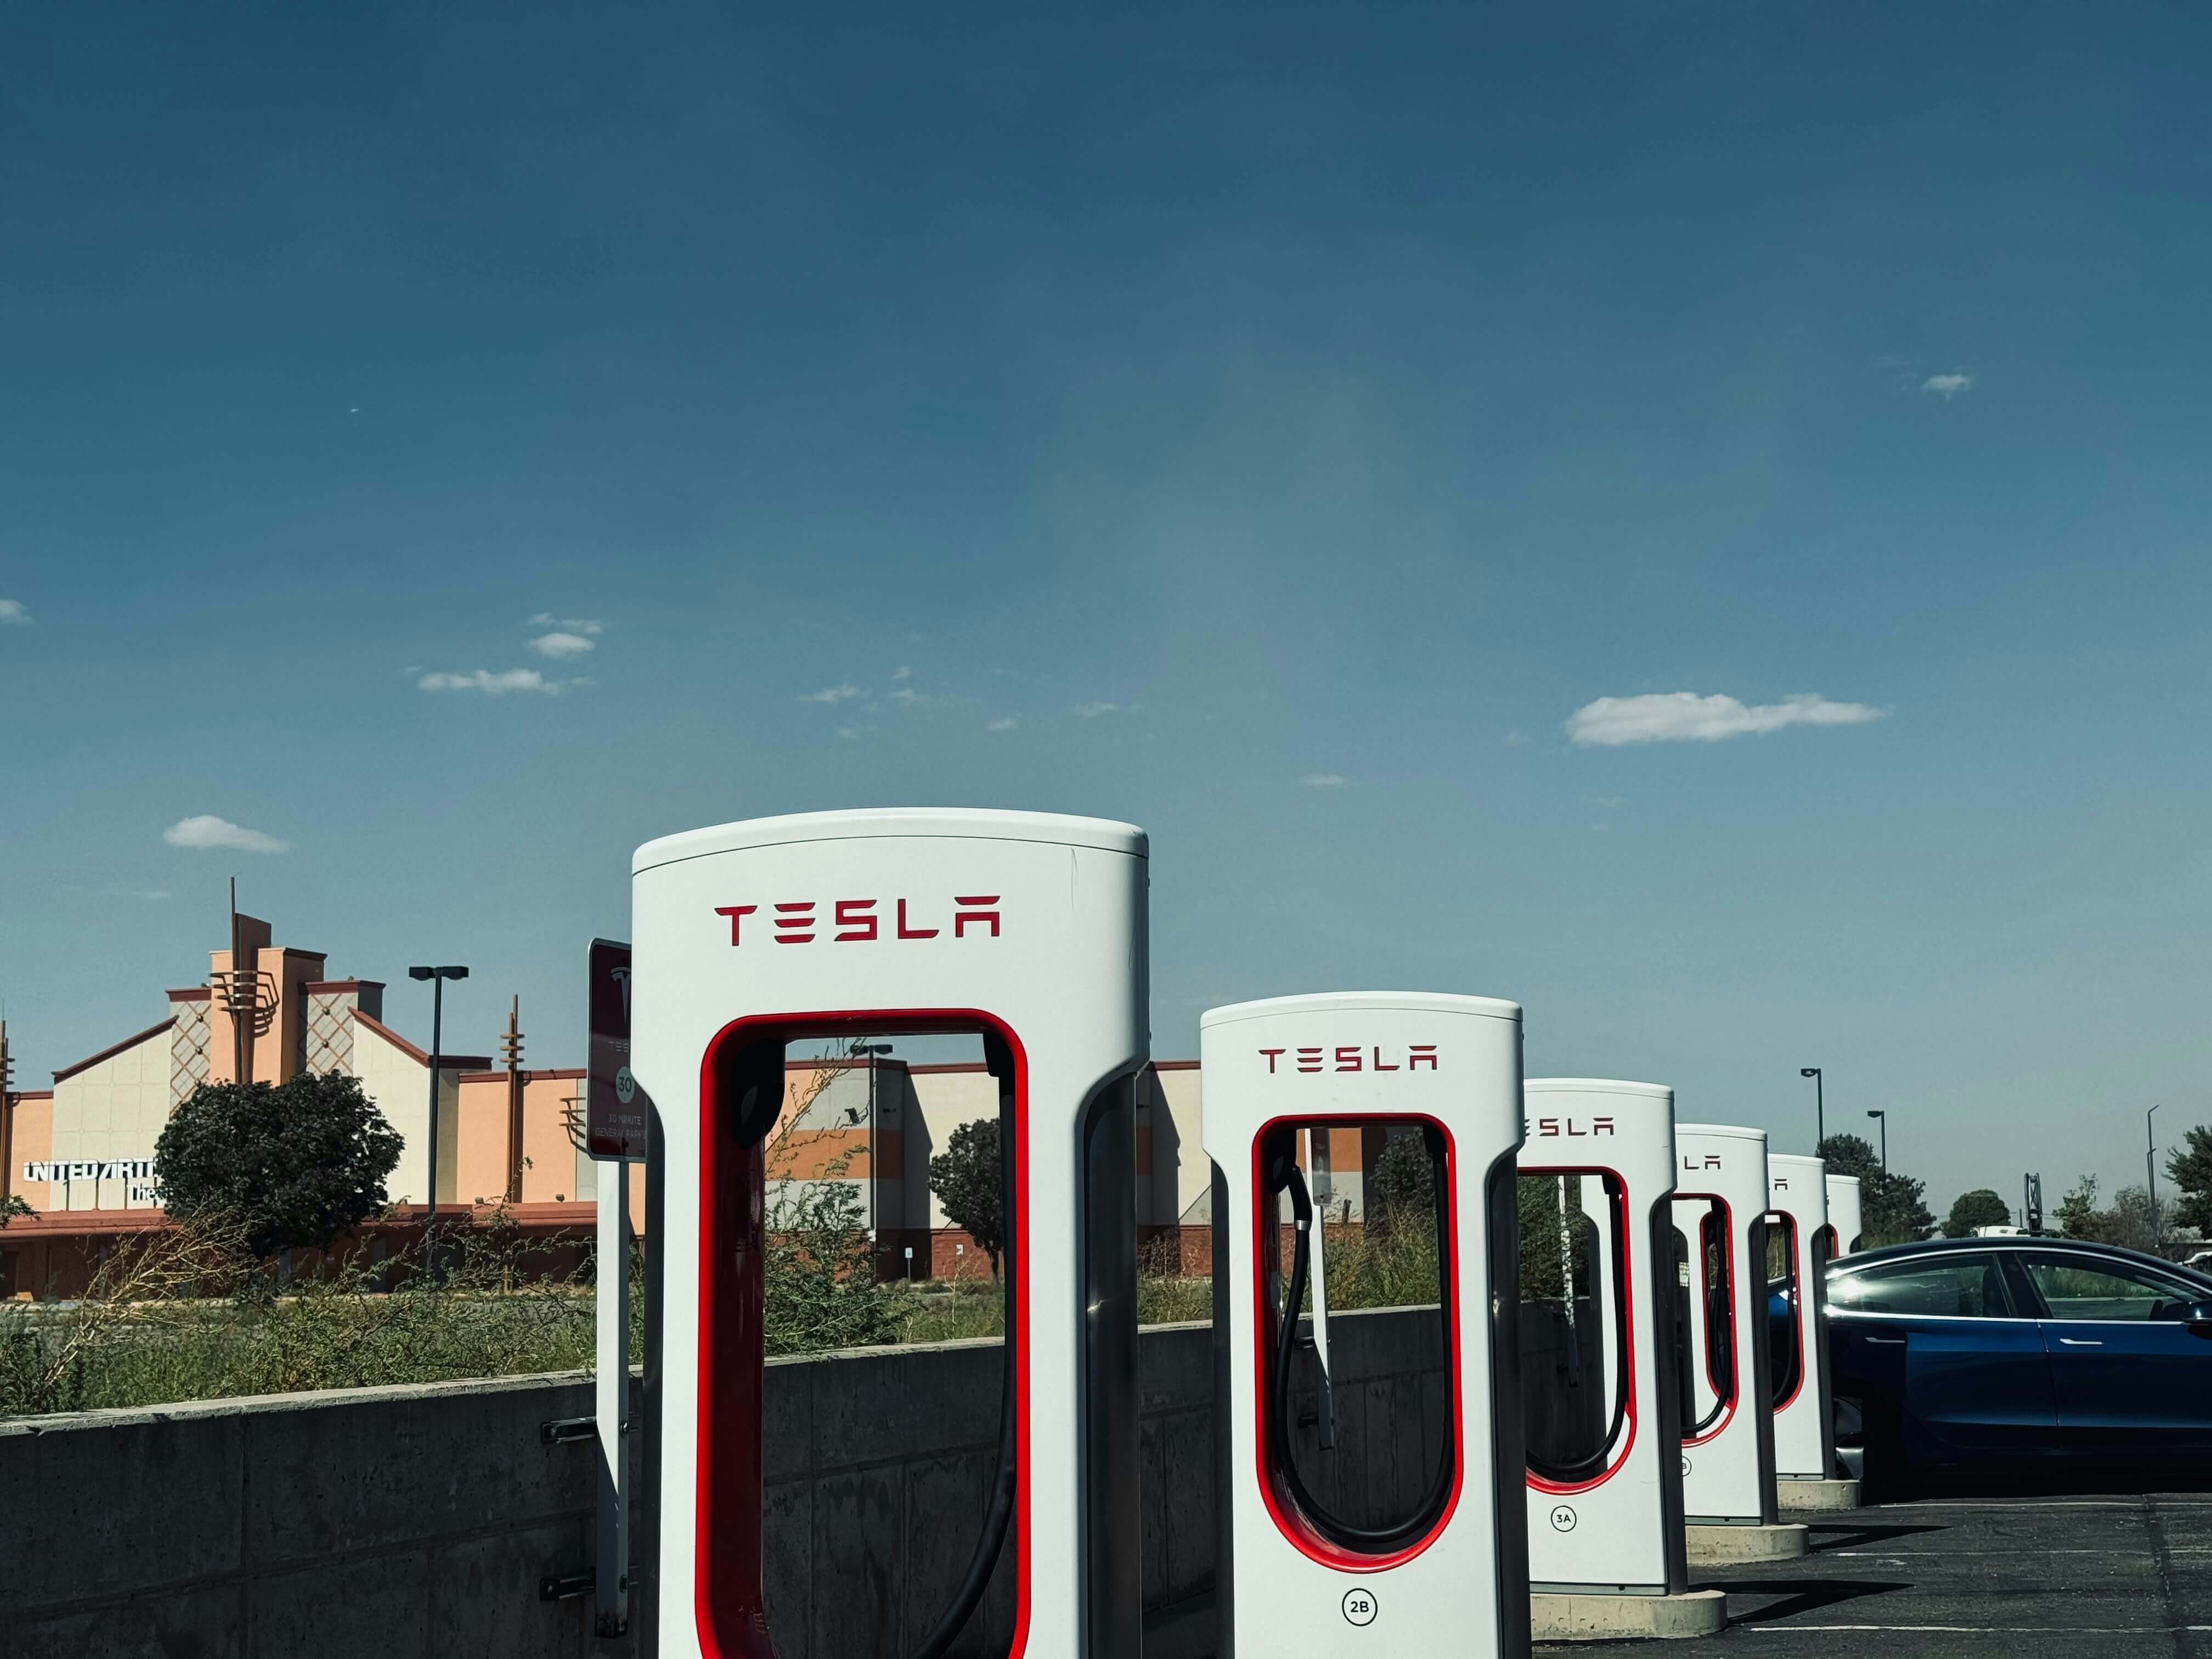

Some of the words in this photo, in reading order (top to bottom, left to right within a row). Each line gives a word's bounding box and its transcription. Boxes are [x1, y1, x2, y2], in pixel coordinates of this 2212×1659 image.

[714, 896, 1001, 946] TESLA
[1259, 1045, 1437, 1073] TESLA
[619, 1076, 632, 1093] 30
[618, 1114, 641, 1125] MINUTE
[596, 1127, 624, 1137] GENERAL
[24, 1159, 99, 1182] UNITED
[1556, 1514, 1572, 1523] 3A
[1350, 1601, 1369, 1613] 2B
